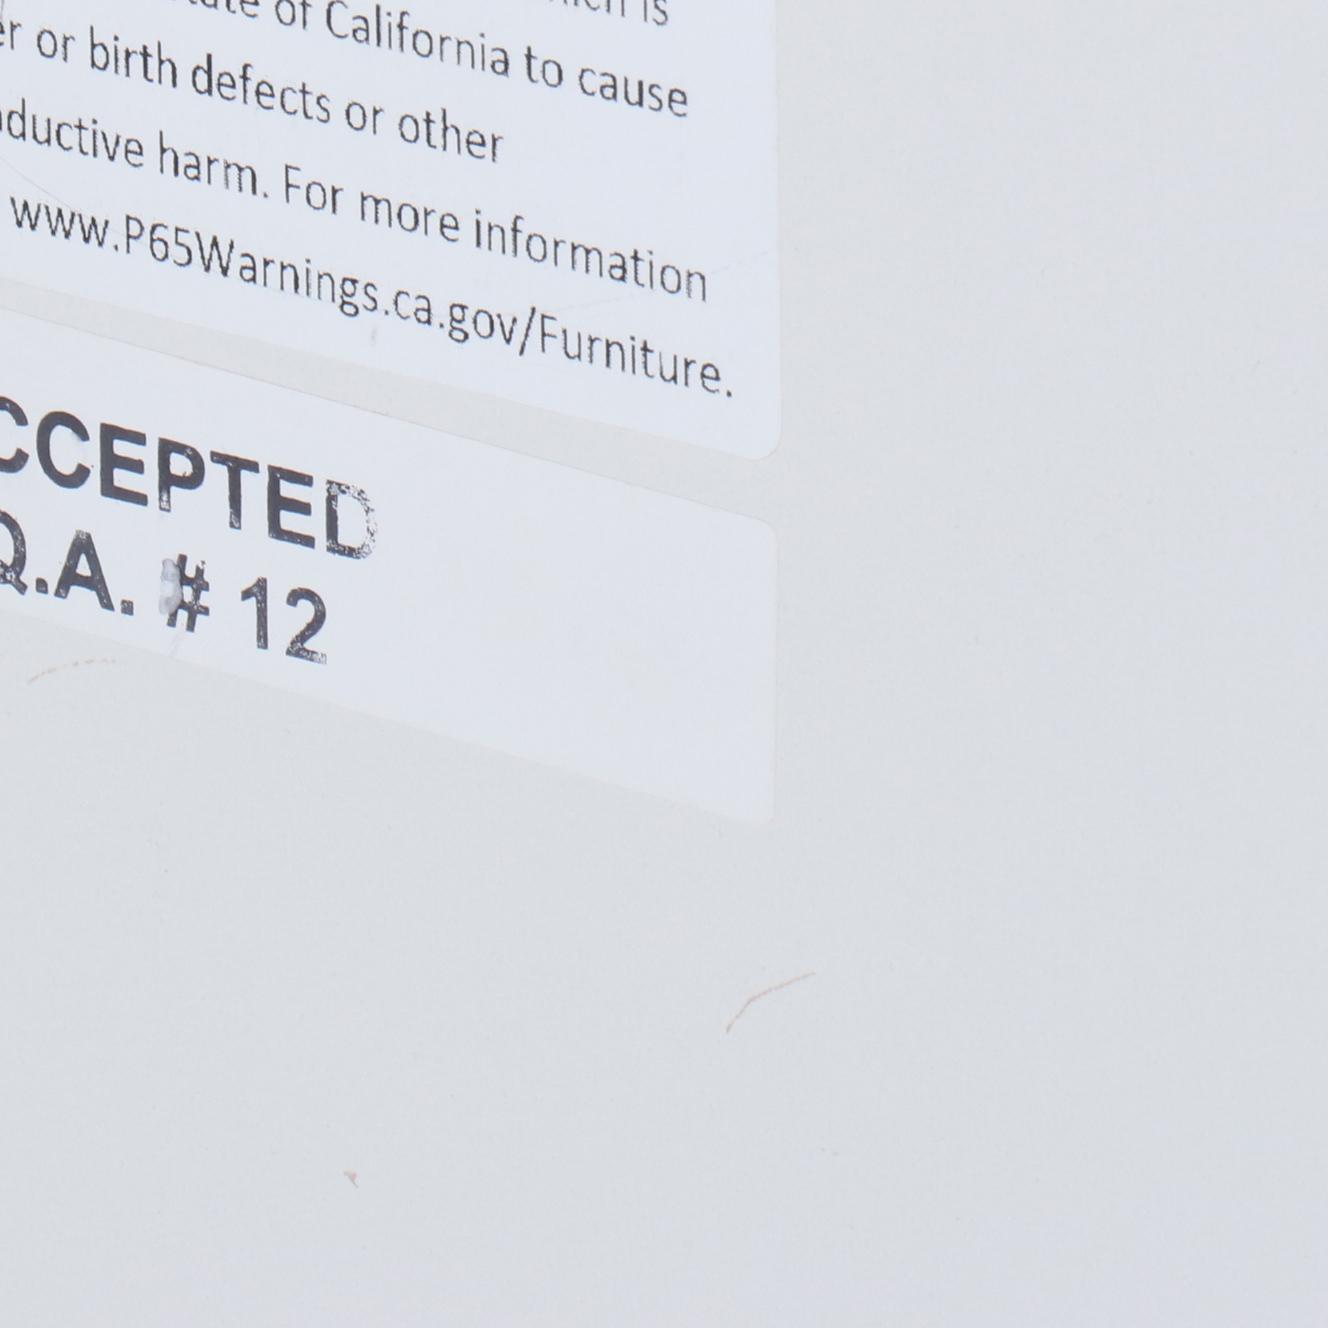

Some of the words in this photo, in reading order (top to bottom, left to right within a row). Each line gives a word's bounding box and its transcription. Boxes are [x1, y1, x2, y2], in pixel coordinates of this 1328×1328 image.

[37, 28, 75, 62] or
[90, 25, 177, 89] birth
[192, 53, 330, 124] defects
[345, 101, 384, 135] or
[398, 109, 504, 163] other
[327, 0, 510, 76] California
[525, 46, 563, 87] to
[579, 65, 688, 117] cause
[160, 130, 269, 199] harm.
[285, 164, 343, 215] For
[360, 191, 460, 242] more
[475, 209, 706, 302] information
[10, 196, 732, 398] www.P65Warnings.ca.gov/Furniture.
[159, 554, 209, 633] #
[241, 577, 327, 665] 12
